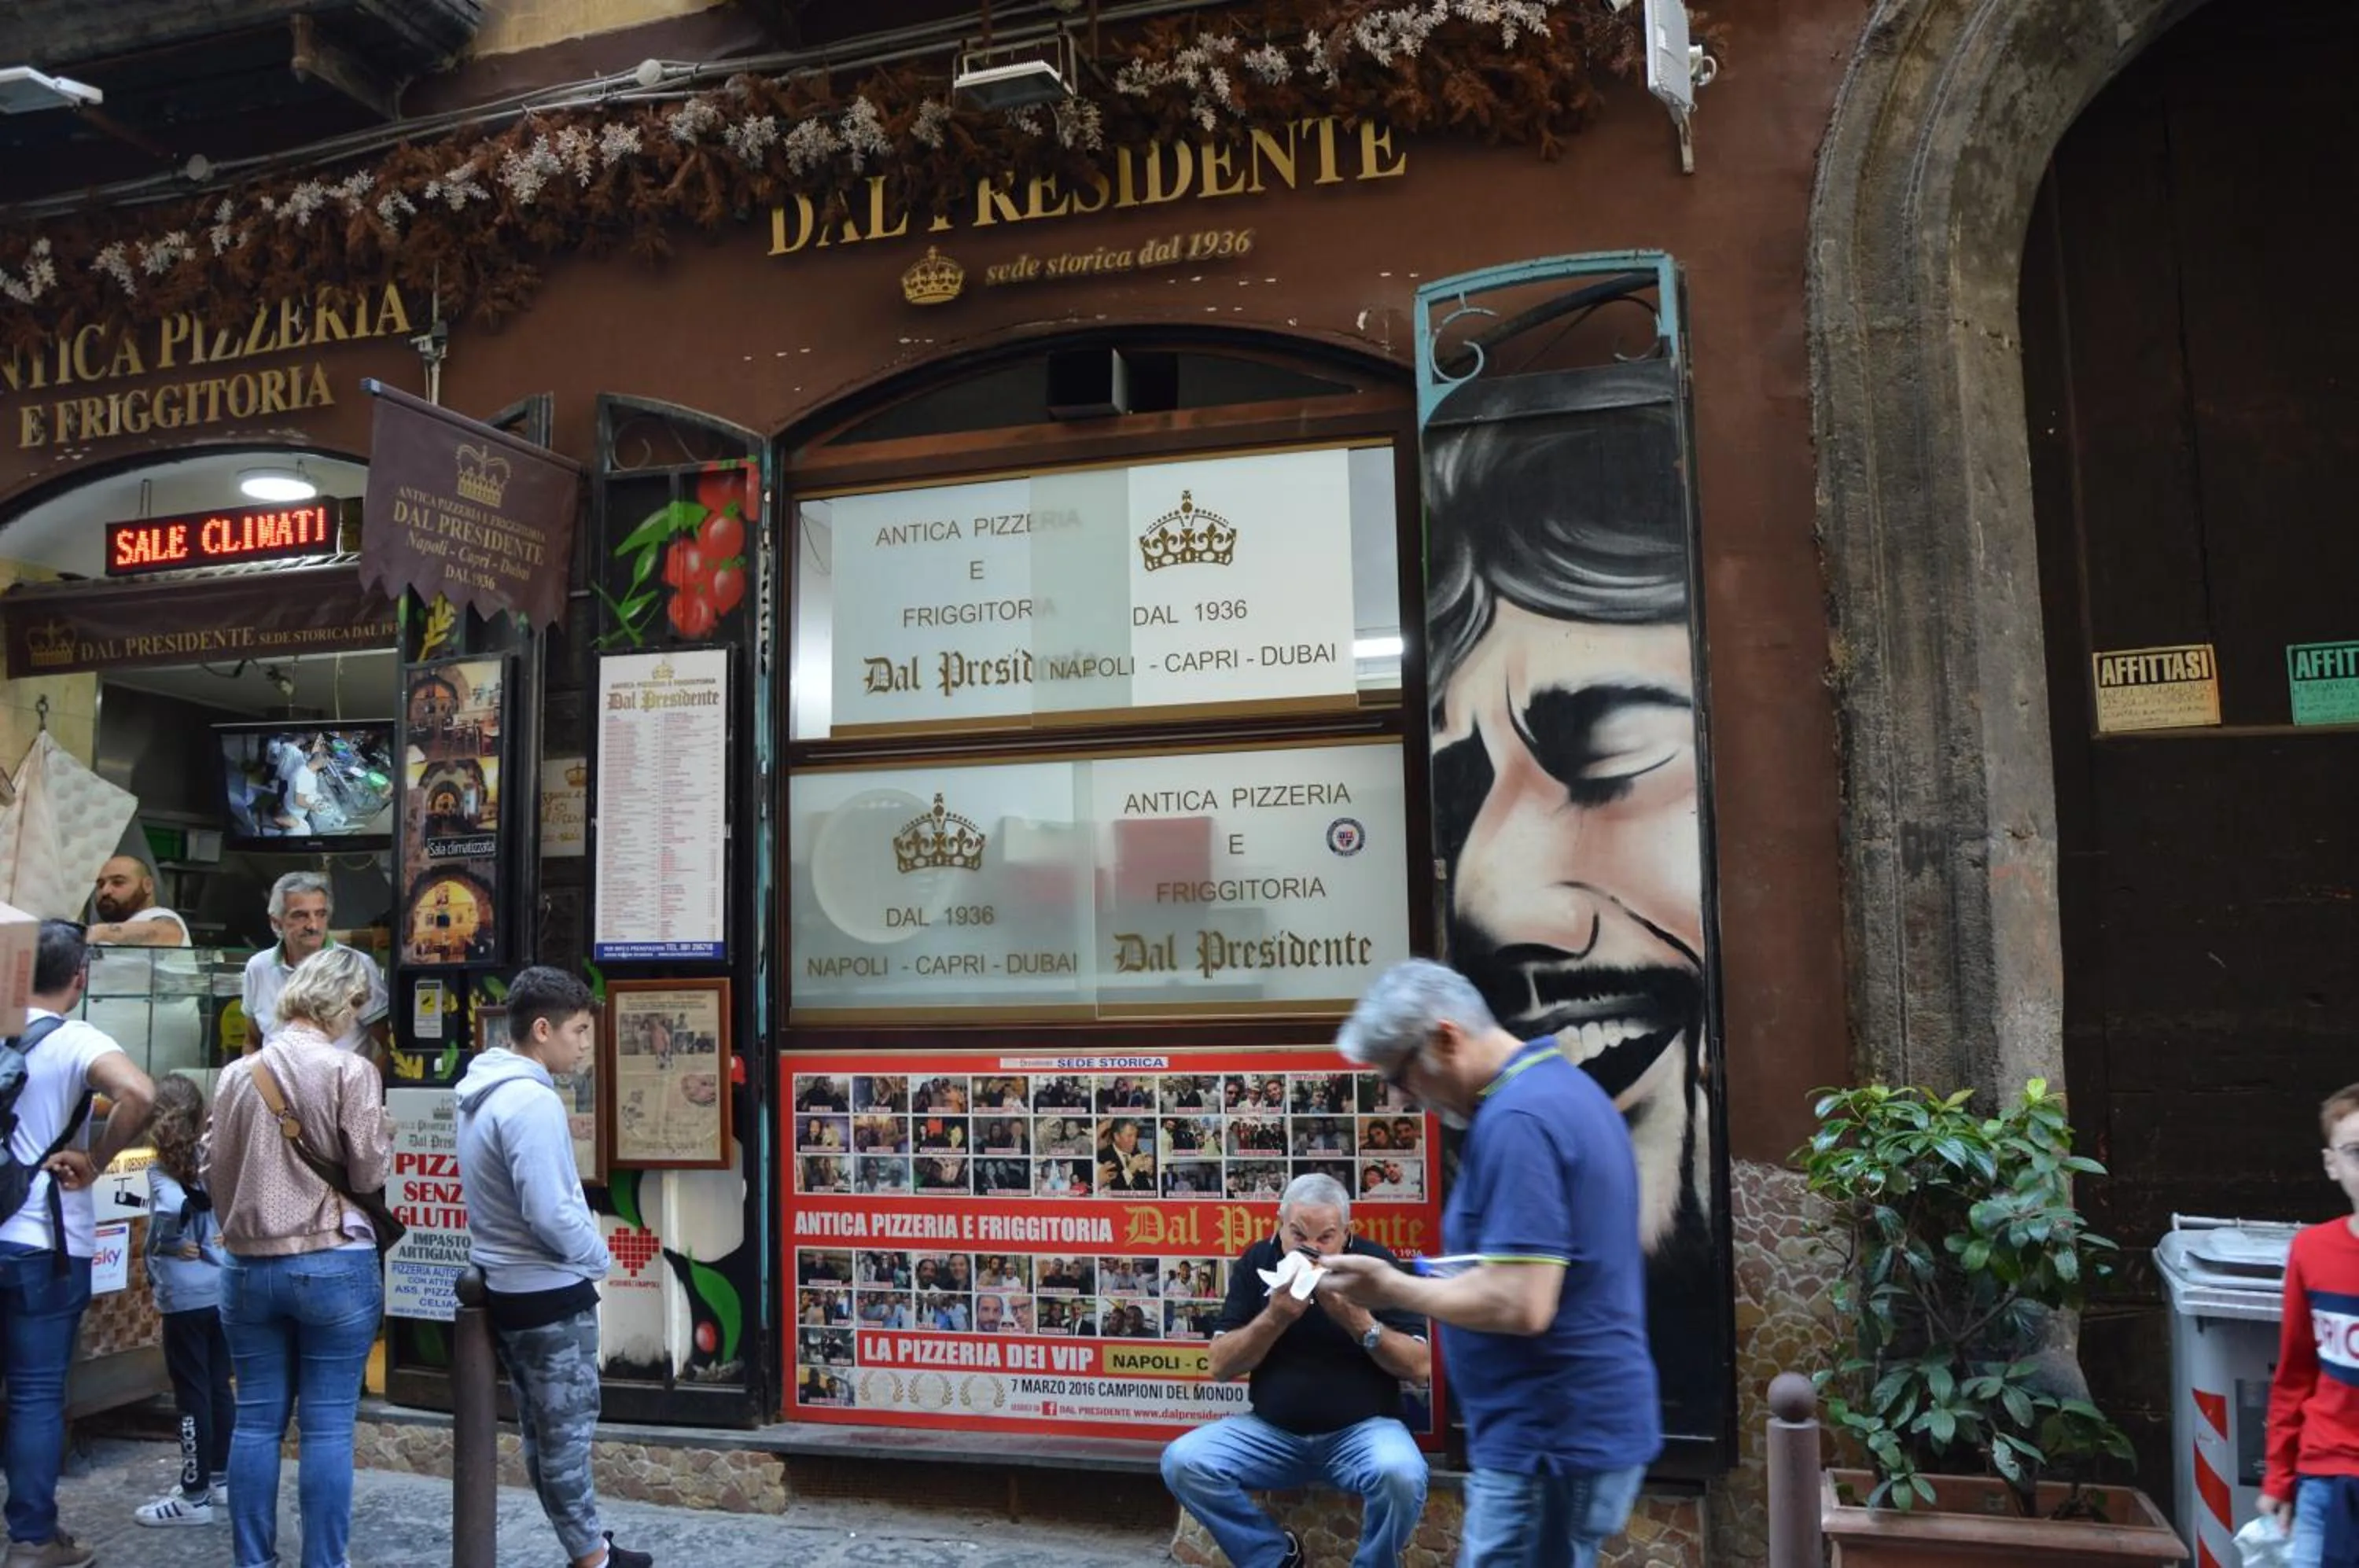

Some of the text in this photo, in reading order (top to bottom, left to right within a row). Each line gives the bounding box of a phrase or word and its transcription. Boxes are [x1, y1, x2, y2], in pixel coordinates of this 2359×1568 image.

[985, 229, 1253, 285] sede storica dal 1936
[20, 362, 336, 449] E FRIGGITORIA
[116, 525, 187, 566] SALE
[394, 500, 544, 566] DAL PRESIDENTE
[406, 529, 448, 556] Napoli
[875, 519, 962, 547] ANTICA
[445, 565, 469, 585] DAL
[970, 561, 984, 580] E
[1132, 599, 1248, 627] DAL 1936
[81, 639, 122, 662] DAL
[125, 627, 255, 657] PRESIDENTE
[259, 631, 290, 645] SEDE
[293, 627, 350, 642] STORICA
[353, 624, 378, 639] DAL
[863, 651, 922, 695] Dal
[1048, 656, 1136, 681] NAPOLI
[1165, 649, 1239, 674] CAPRI
[1260, 642, 1336, 667] DUBAI
[2101, 650, 2210, 686] AFFITTASI
[2296, 647, 2359, 679] AFFIT
[606, 688, 719, 712] Dal Presidente
[1124, 782, 1352, 815] ANTICA PIZZERIA
[429, 841, 496, 856] Sala climatizzata
[1228, 834, 1244, 856] E
[1156, 877, 1327, 904] FRIGGITORIA
[885, 904, 995, 928] DAL 1936
[807, 955, 889, 977] NAPOLI
[915, 953, 985, 976] CAPRI
[1007, 951, 1079, 974] DUBAI
[1113, 930, 1373, 979] Dal Presidente
[1058, 1058, 1097, 1068] SEDE
[1099, 1058, 1165, 1068] STORICA
[396, 1153, 461, 1178] PIZZ
[403, 1180, 466, 1204] SENZ
[393, 1205, 469, 1229] GLUTI
[794, 1211, 1113, 1243] ANTICA PIZZERIA E FRIGGITORIA
[1124, 1204, 1201, 1246] Dal
[398, 1245, 470, 1263] ARTIGIANA
[413, 1233, 471, 1249] IMPASTO
[93, 1246, 122, 1268] sky
[419, 1298, 455, 1309] CELIA
[864, 1337, 1095, 1371] LA PIZZERIA DEI VIP
[1113, 1353, 1180, 1370] NAPOLI
[1011, 1378, 1243, 1403] 7 MARZO 2016 CAMPIONI DEL MONDO
[1059, 1405, 1076, 1415] DAL
[1078, 1406, 1132, 1418] PRESIDENTE
